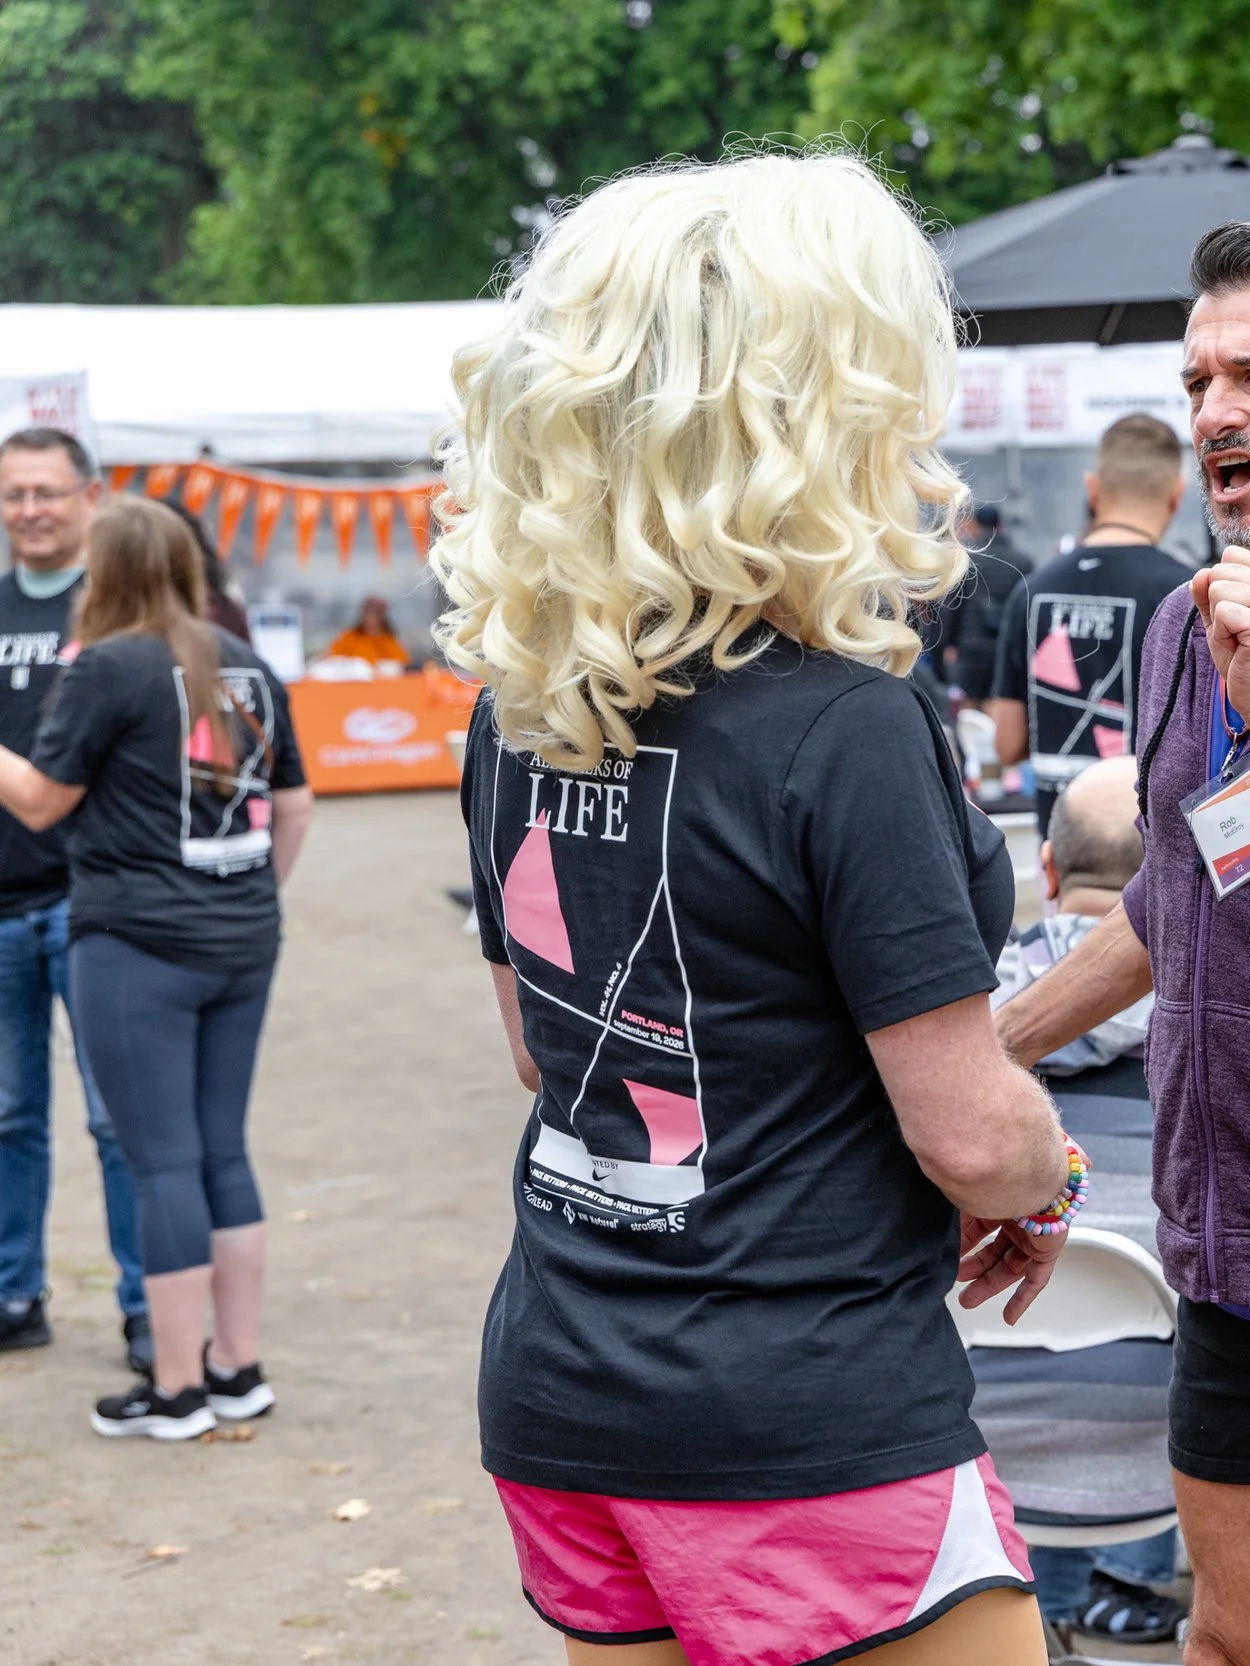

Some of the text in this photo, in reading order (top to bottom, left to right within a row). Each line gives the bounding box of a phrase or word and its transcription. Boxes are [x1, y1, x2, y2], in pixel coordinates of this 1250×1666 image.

[613, 761, 633, 779] OF
[525, 772, 629, 842] LIFE
[1219, 816, 1237, 832] Rob
[1235, 864, 1245, 873] T2
[621, 1009, 684, 1038] PORTLAND, OR
[542, 1173, 569, 1189] SETTERS
[568, 1184, 589, 1196] PACE
[585, 1189, 615, 1207] SETTERS
[615, 1200, 632, 1213] PACE
[526, 1193, 553, 1212] GILEAD
[630, 1219, 667, 1233] strategy
